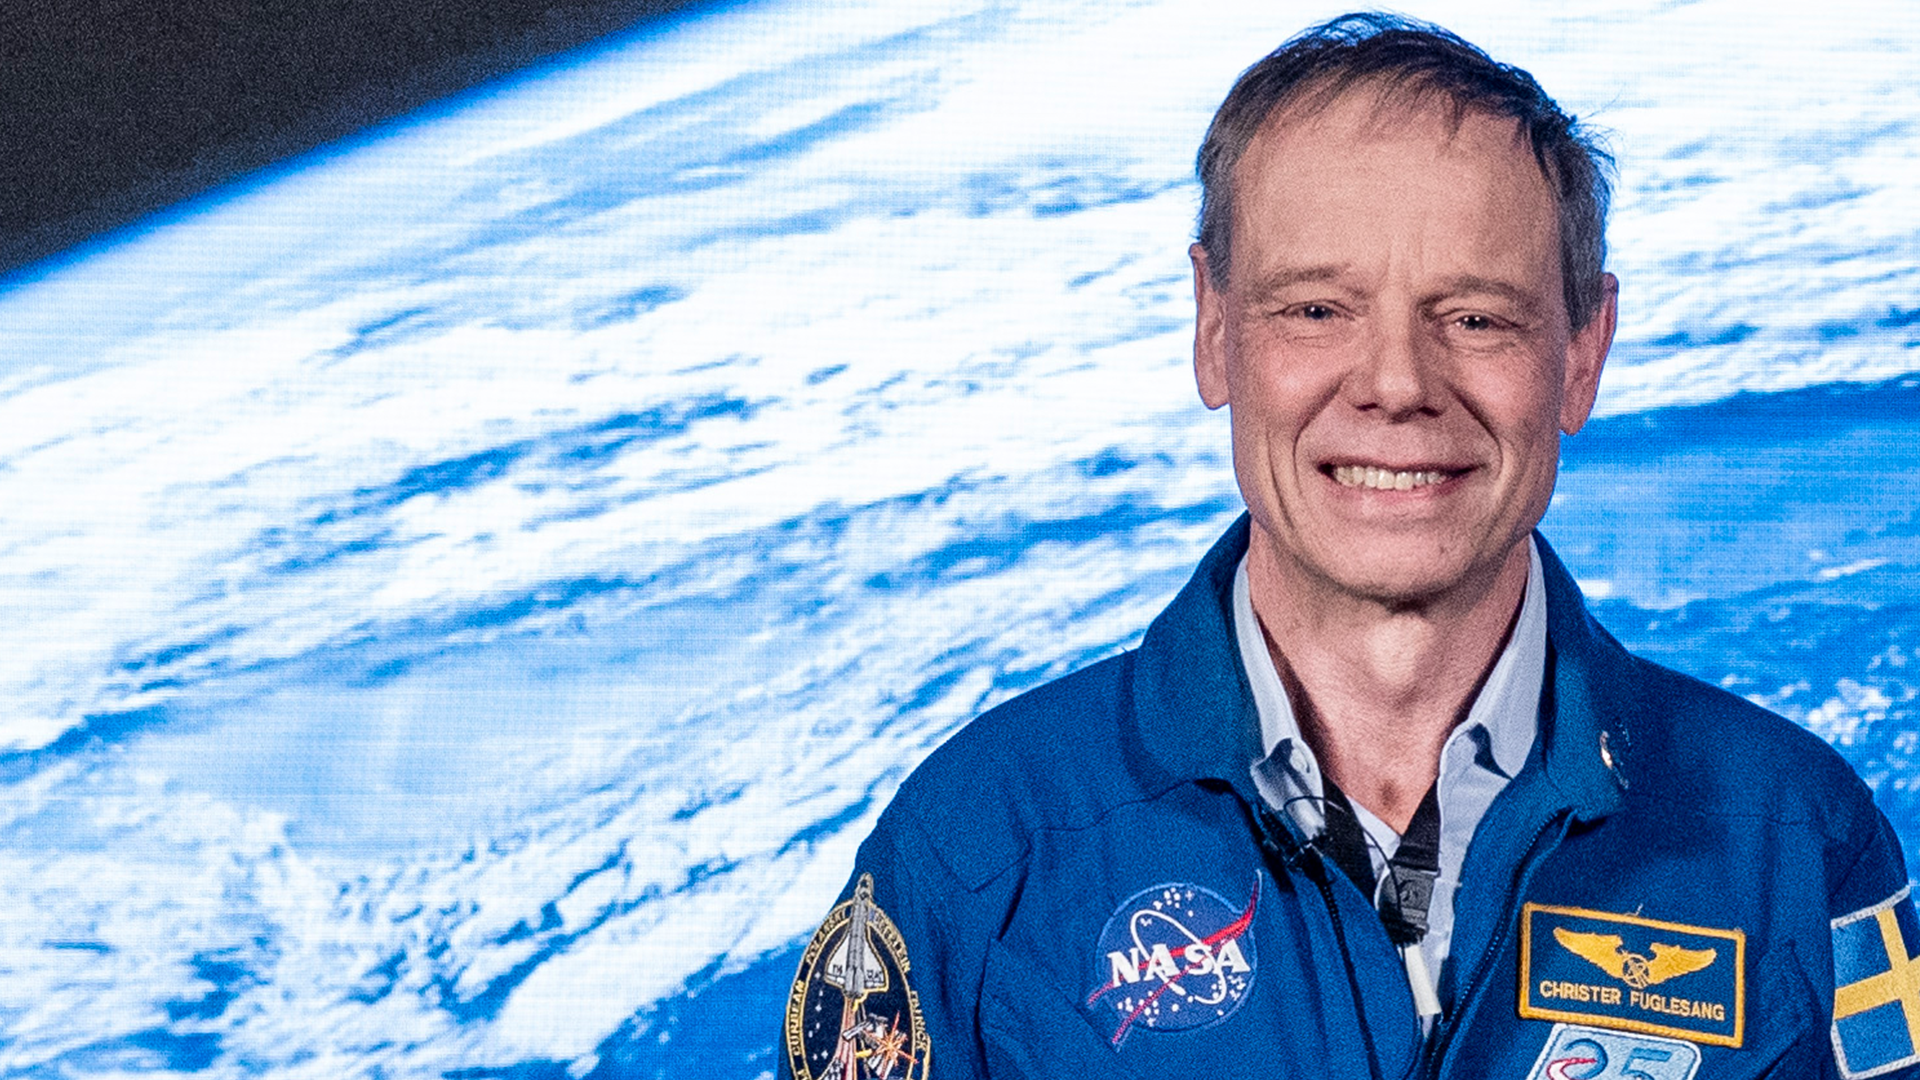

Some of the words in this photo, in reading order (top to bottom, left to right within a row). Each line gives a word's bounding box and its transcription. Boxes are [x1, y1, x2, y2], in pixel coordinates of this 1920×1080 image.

[1107, 938, 1251, 988] NASA
[1539, 980, 1621, 1005] CHRISTER
[1630, 991, 1725, 1021] FUGLESANG
